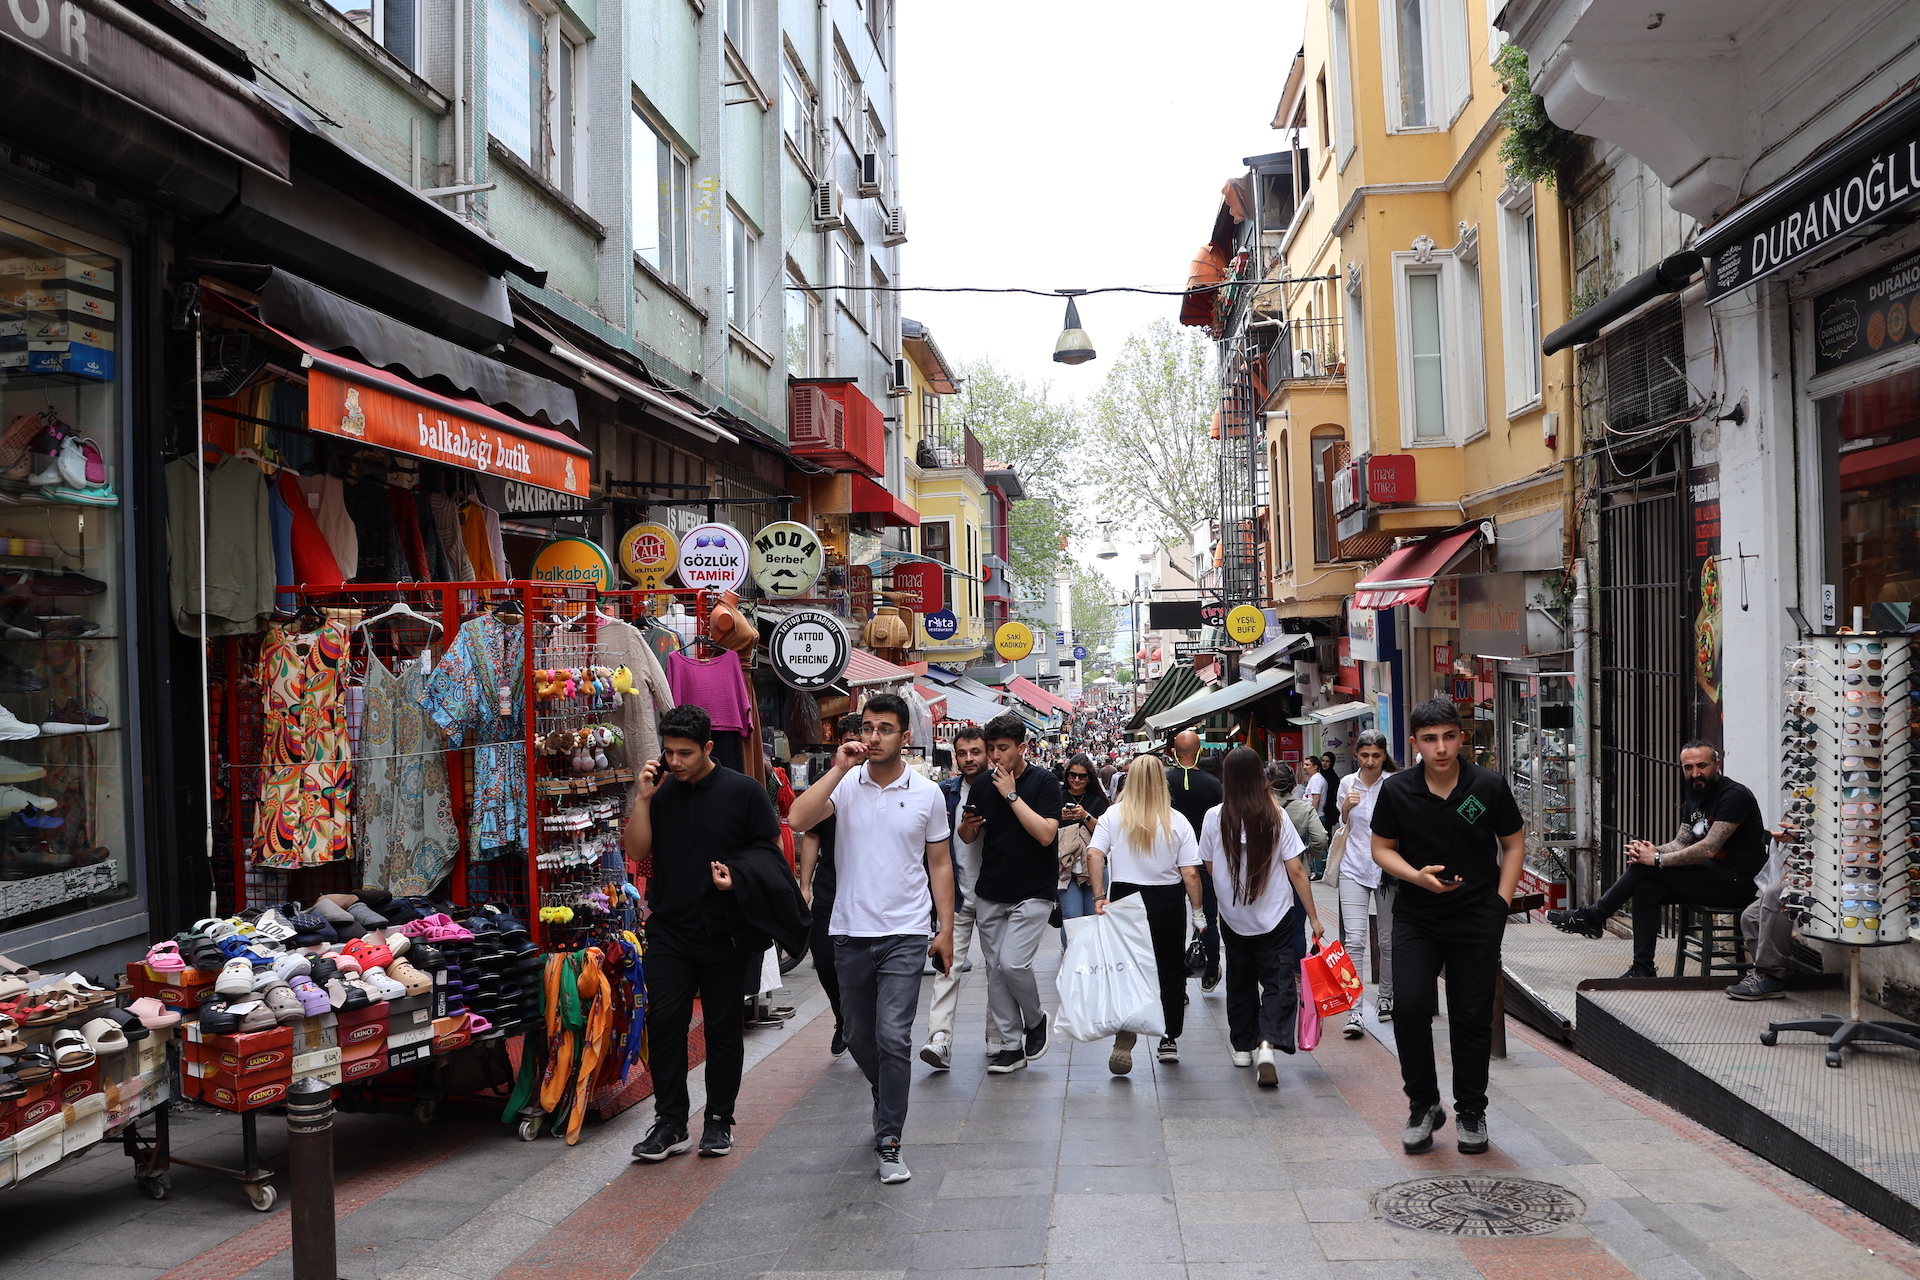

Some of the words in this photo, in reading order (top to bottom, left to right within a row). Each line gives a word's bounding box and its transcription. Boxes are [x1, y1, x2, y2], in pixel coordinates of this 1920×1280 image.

[1751, 140, 1920, 275] DURANOĞLU
[1820, 317, 1857, 339] DURANOĞLU
[418, 412, 492, 471] balkabağı
[496, 448, 531, 475] butik
[631, 540, 667, 563] KALE
[755, 531, 817, 559] MODA
[684, 554, 739, 567] GÖZLÜK
[766, 554, 805, 565] Berber
[536, 564, 604, 584] balkabağı
[688, 568, 735, 581] TAMİRİ
[1201, 607, 1225, 619] Tiry
[1497, 602, 1519, 631] Saat
[778, 617, 801, 634] TATTOO
[1211, 618, 1224, 626] Ca
[1236, 614, 1257, 626] YEŞİL
[1237, 625, 1257, 634] BÜFE
[793, 632, 824, 641] TATTOO
[805, 643, 812, 653] &
[789, 655, 829, 664] PIERCING
